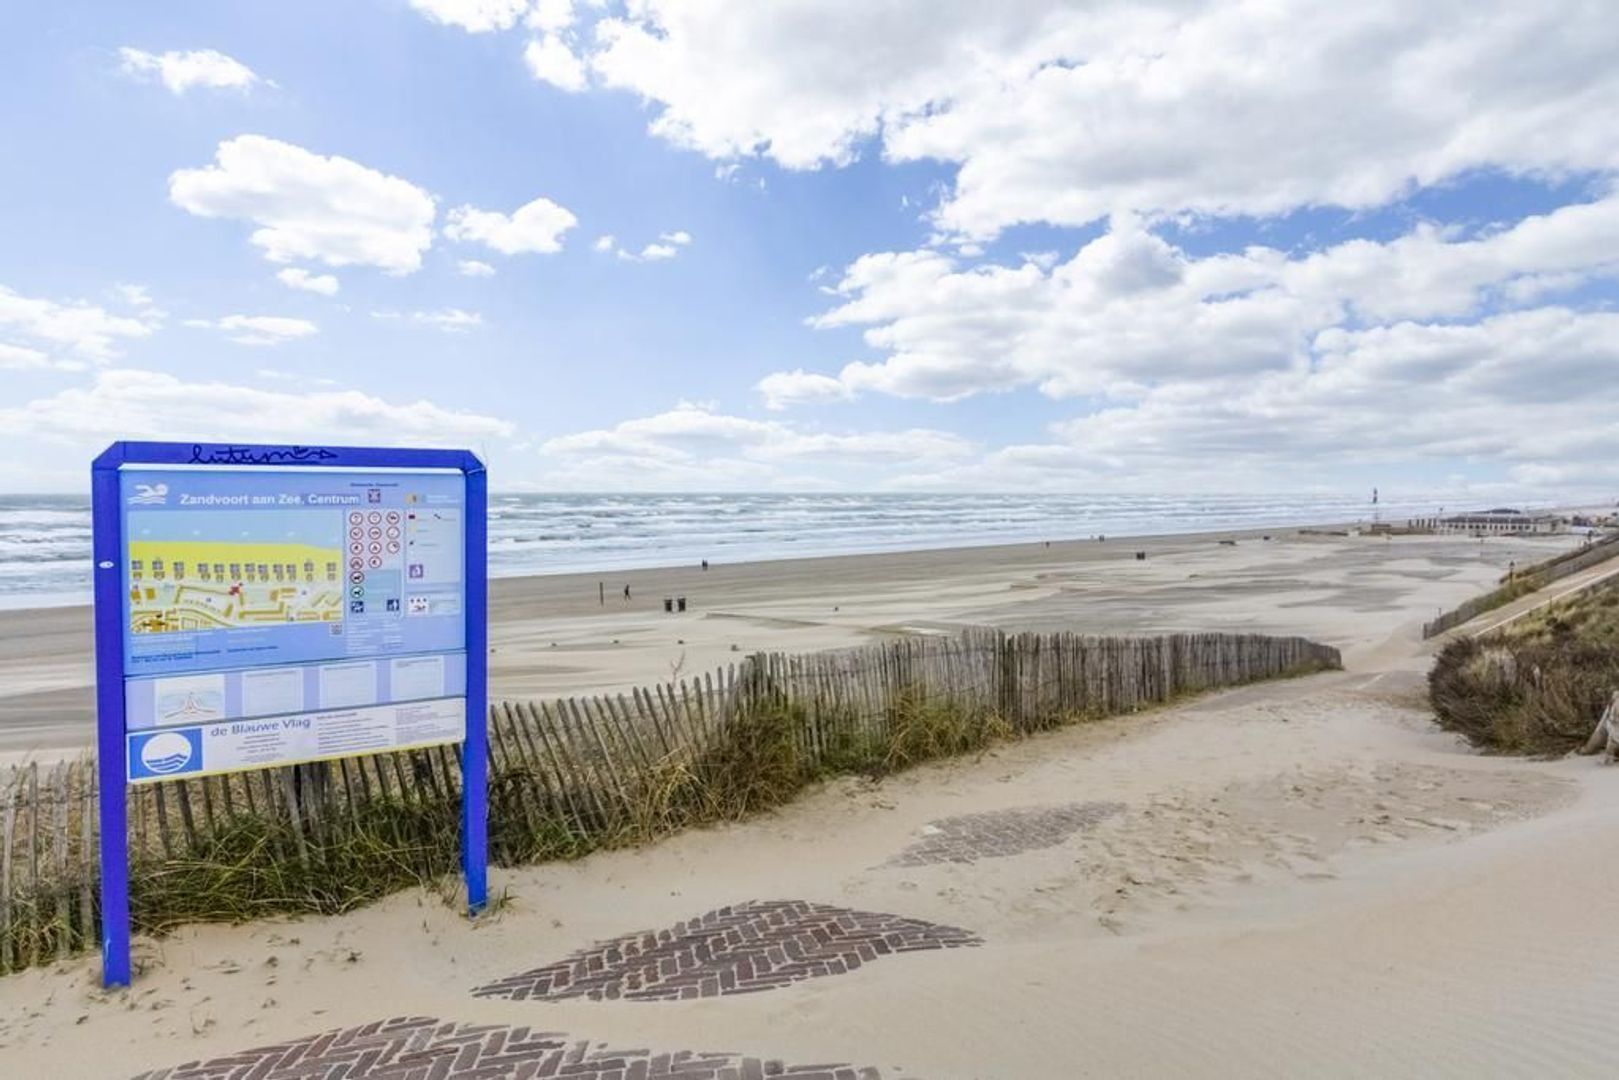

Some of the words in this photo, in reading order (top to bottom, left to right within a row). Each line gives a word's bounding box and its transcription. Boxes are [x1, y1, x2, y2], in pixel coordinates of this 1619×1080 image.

[180, 493, 249, 506] Zandvoort
[252, 495, 275, 505] aan
[308, 493, 359, 506] Centrum
[210, 727, 228, 737] de
[232, 722, 279, 735] Blauwe
[282, 718, 311, 729] Vlag
